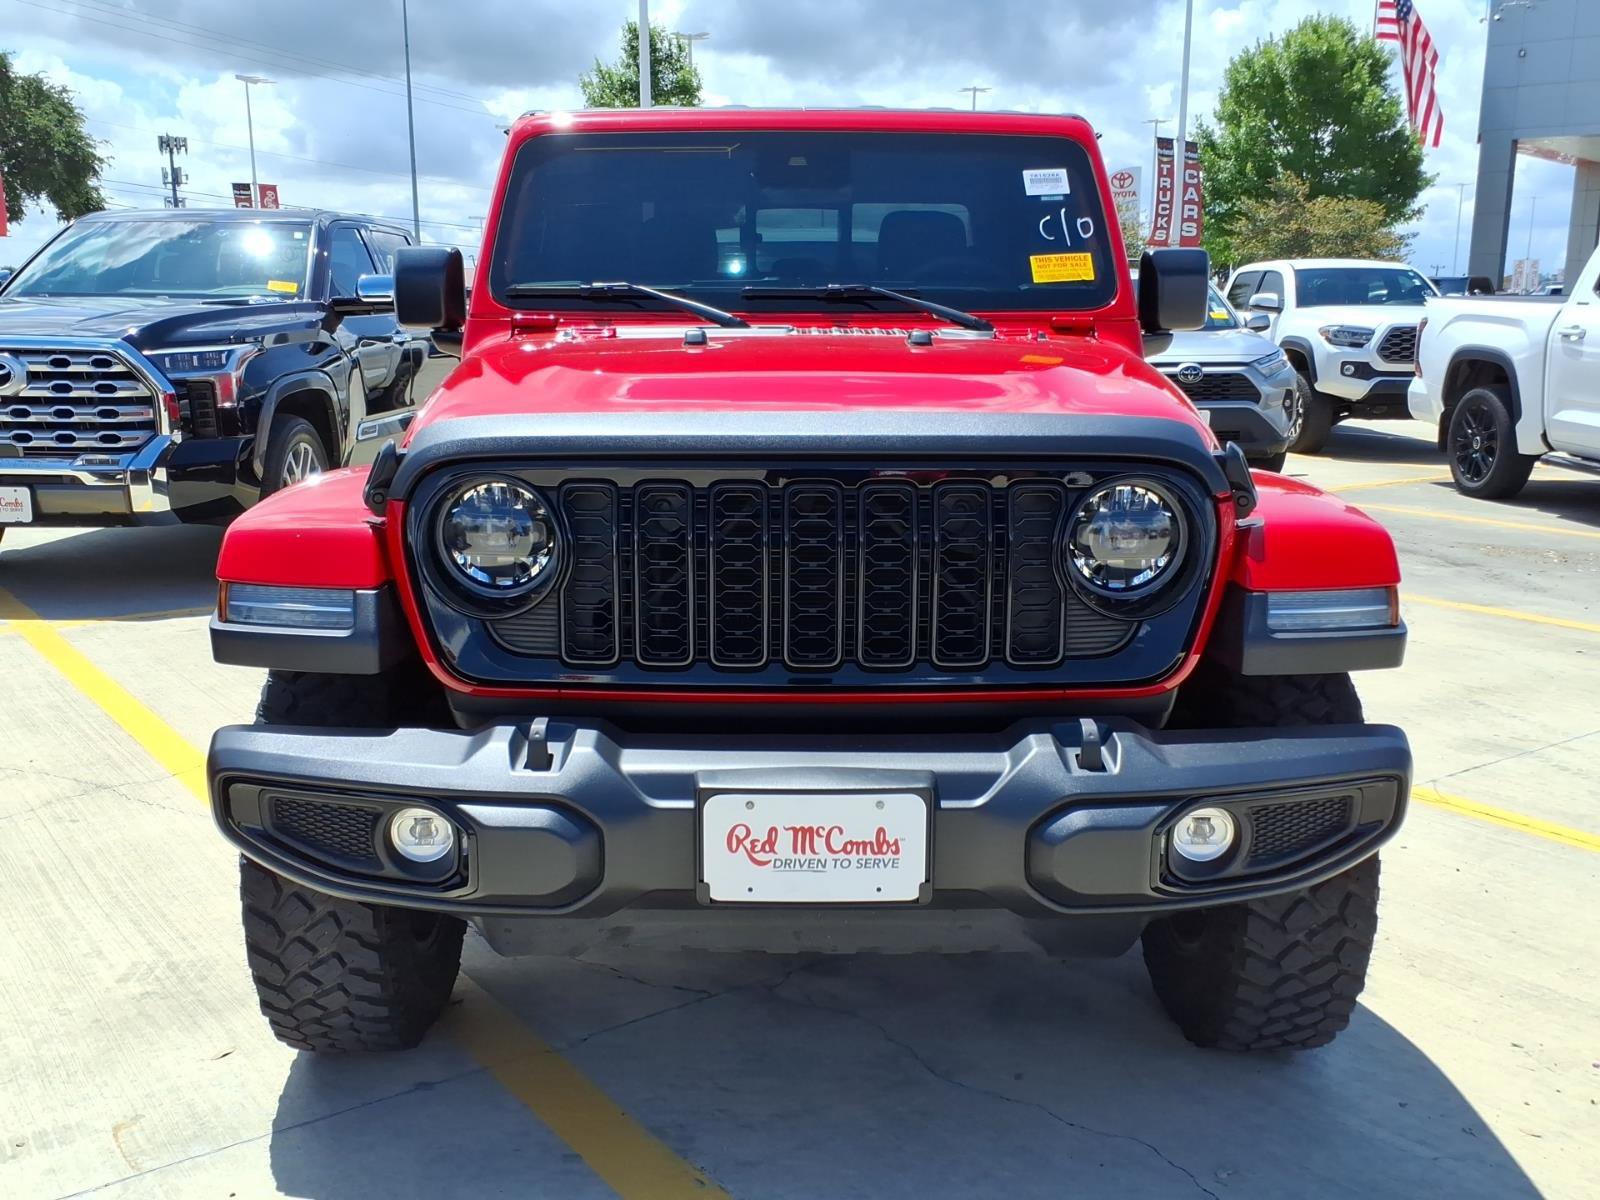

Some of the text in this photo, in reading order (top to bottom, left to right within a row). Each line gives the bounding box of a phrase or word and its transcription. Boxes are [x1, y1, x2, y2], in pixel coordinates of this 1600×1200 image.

[1153, 164, 1172, 241] TRUCKS
[1181, 169, 1199, 237] CARS
[0, 497, 24, 507] Combs
[726, 823, 901, 867] Red McCombs
[772, 858, 900, 869] DRIVEN TO SERVE
